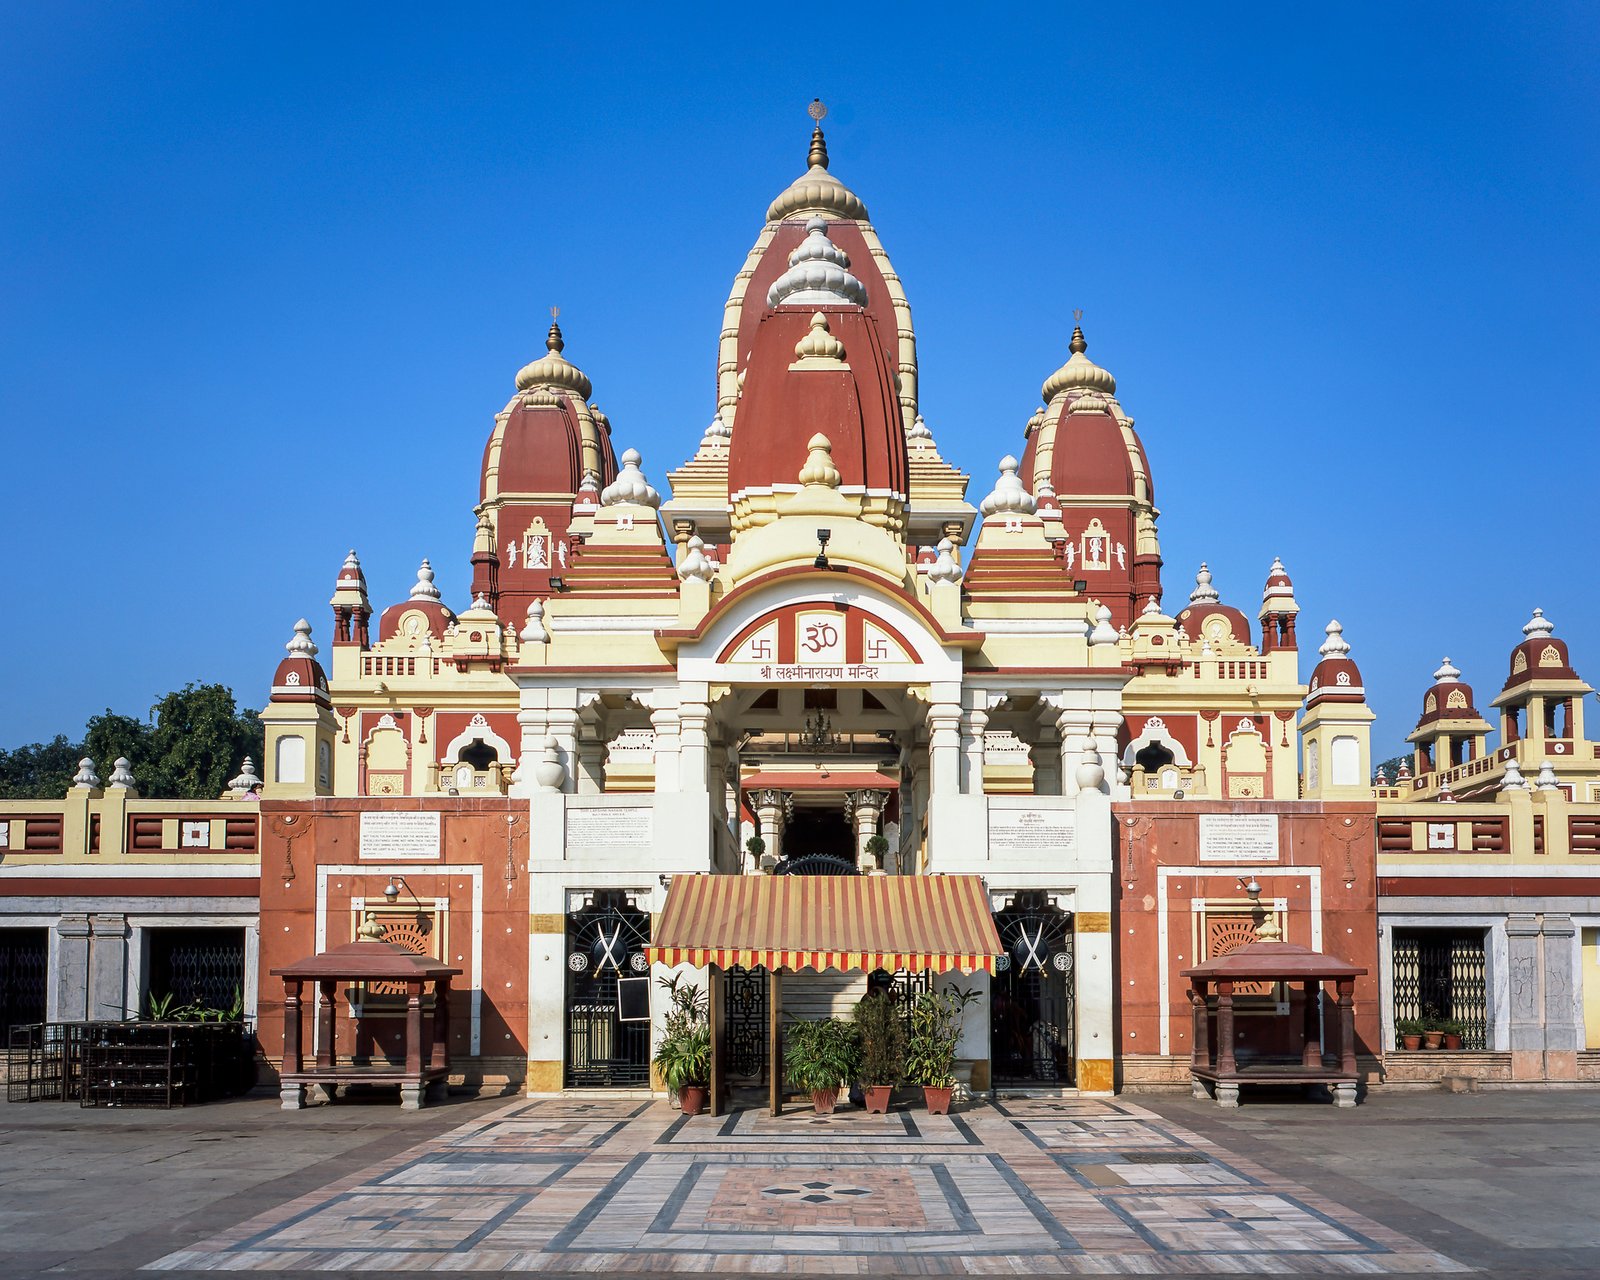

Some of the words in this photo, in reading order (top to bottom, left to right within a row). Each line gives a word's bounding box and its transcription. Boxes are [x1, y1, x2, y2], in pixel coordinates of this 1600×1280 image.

[760, 666, 771, 680] श्री
[776, 666, 843, 680] लक्ष्मीनारायण
[848, 665, 879, 680] मन्दिर
